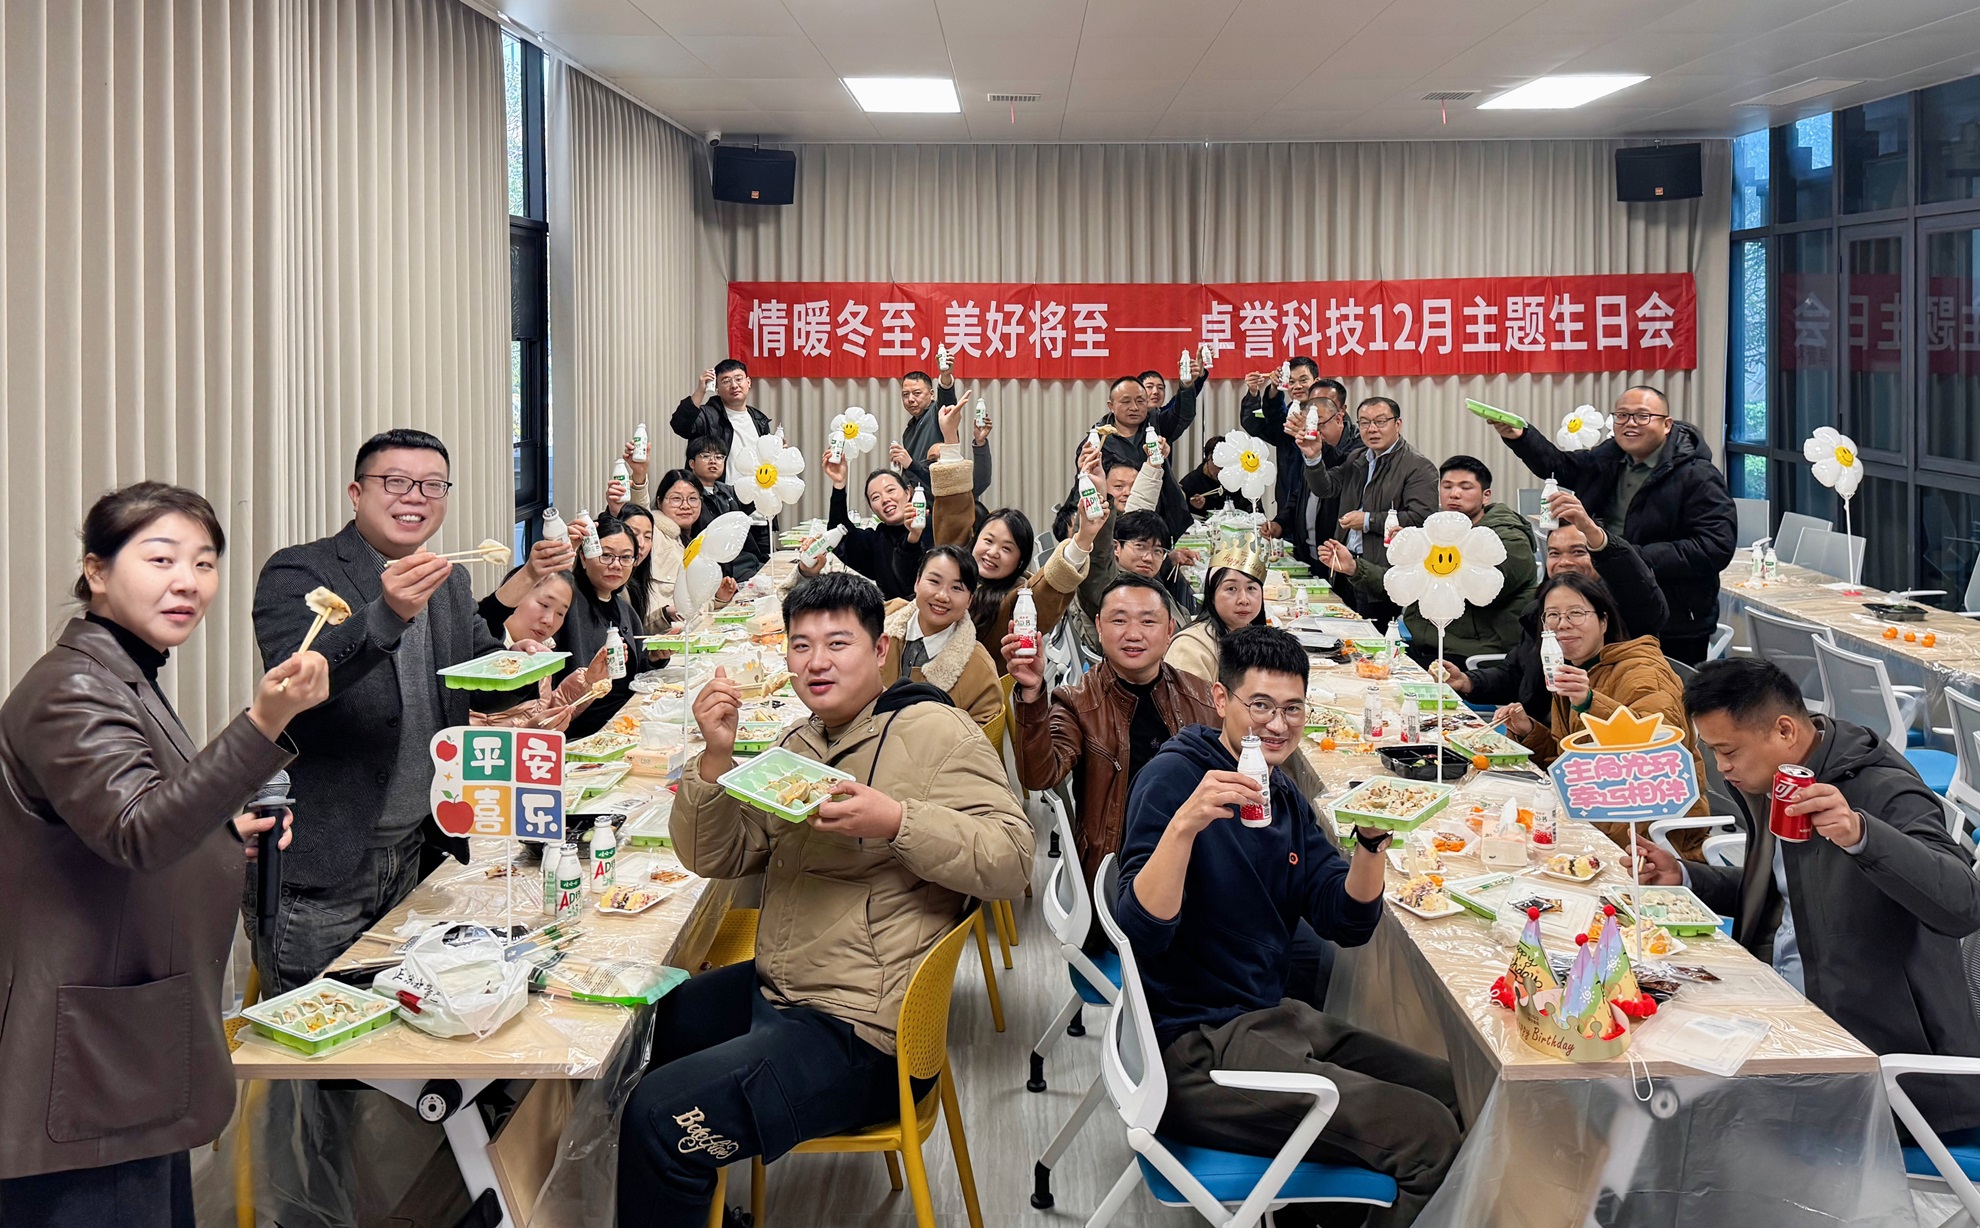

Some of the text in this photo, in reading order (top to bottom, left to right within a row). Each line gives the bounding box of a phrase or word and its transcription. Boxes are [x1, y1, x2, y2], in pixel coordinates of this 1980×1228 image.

[1563, 751, 1682, 783] 主角光环
[1569, 778, 1688, 808] 幸运相伴
[1531, 1026, 1575, 1056] Birthday
